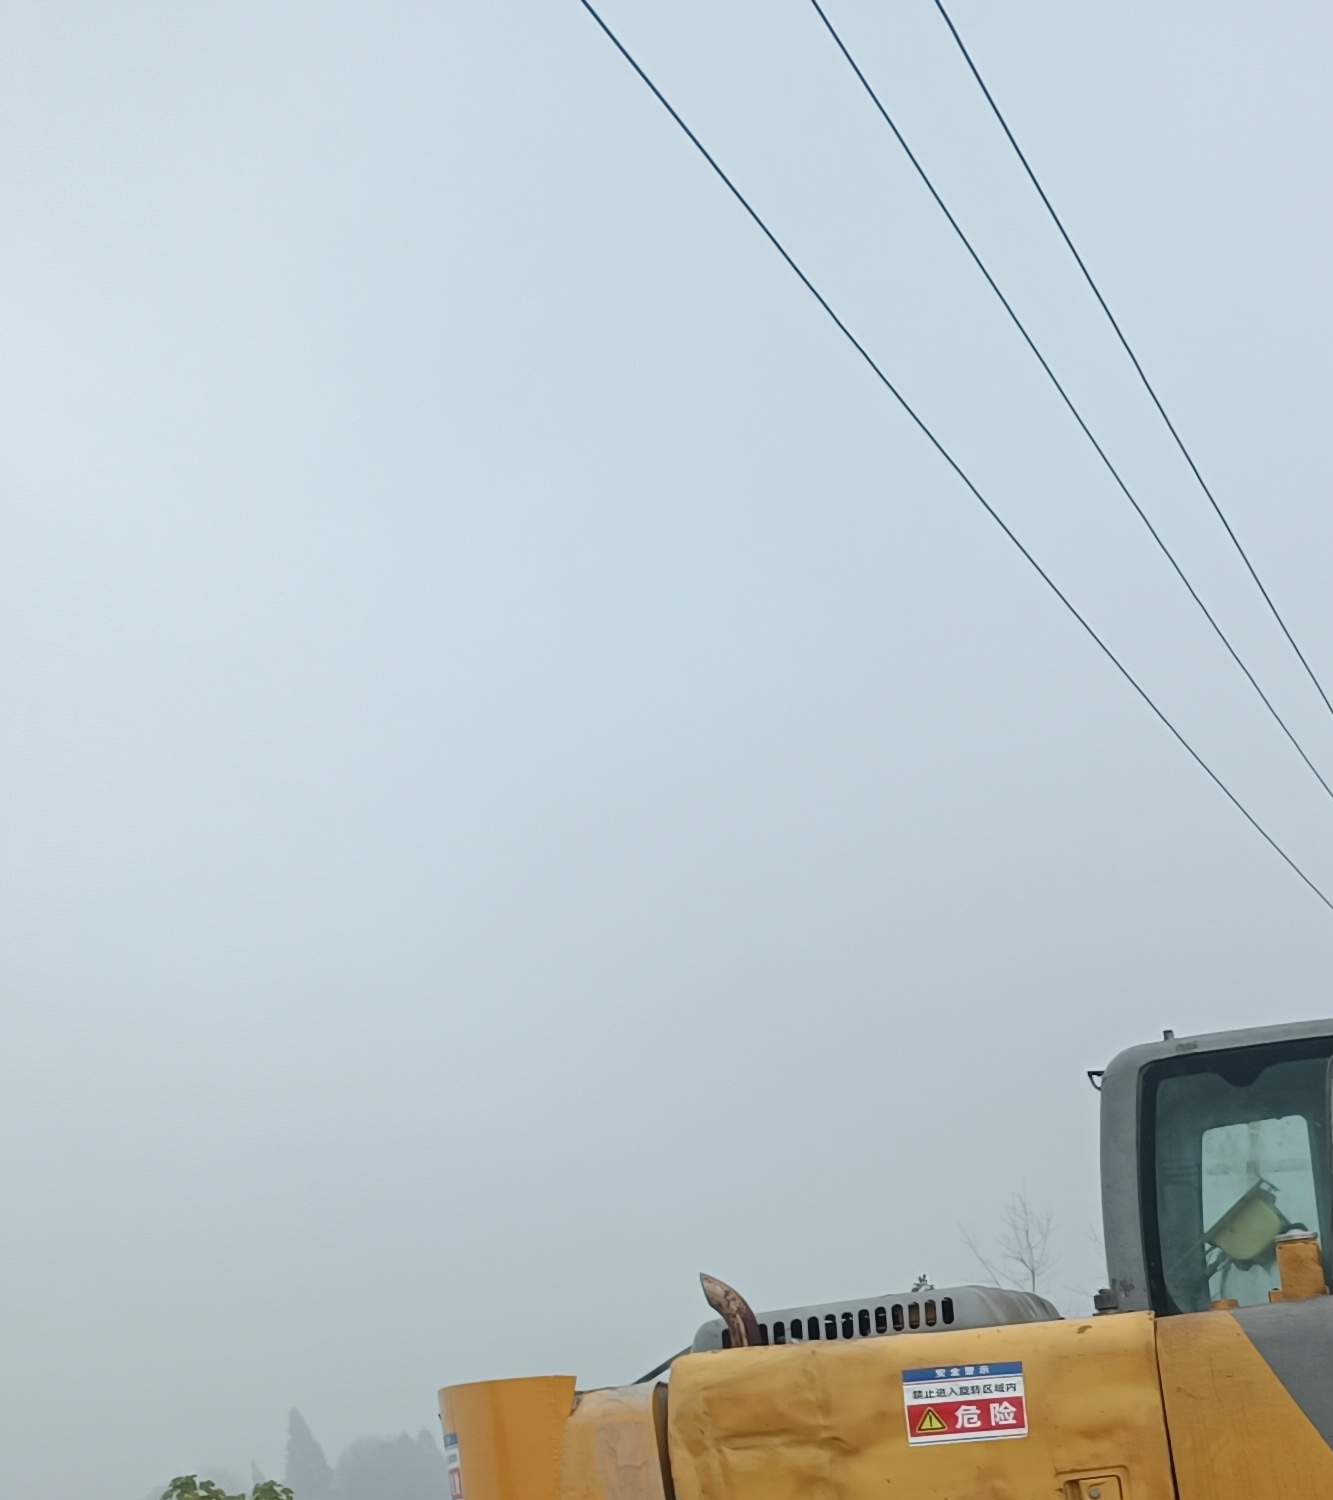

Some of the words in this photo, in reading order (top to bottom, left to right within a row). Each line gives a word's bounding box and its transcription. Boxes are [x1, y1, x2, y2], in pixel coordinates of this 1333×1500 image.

[935, 1365, 990, 1378] 安全警示
[954, 1401, 1017, 1429] 危险
